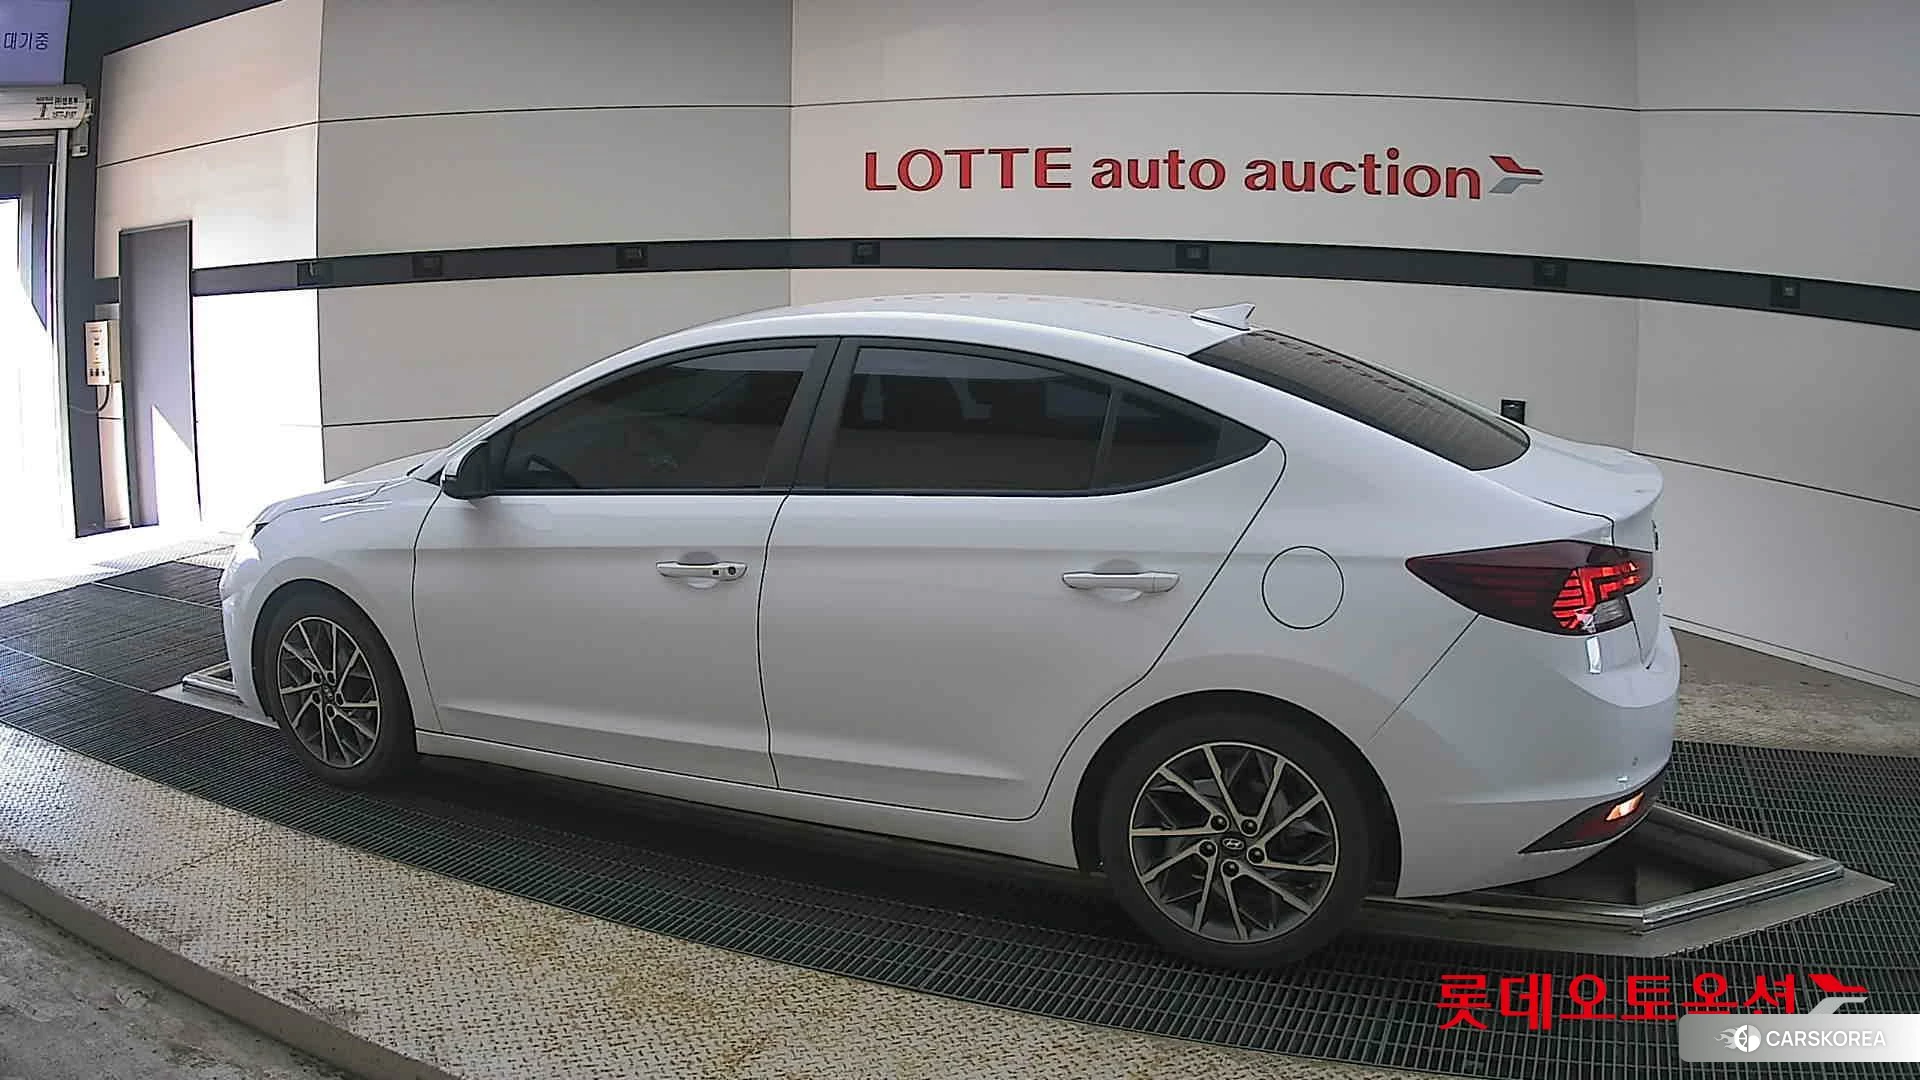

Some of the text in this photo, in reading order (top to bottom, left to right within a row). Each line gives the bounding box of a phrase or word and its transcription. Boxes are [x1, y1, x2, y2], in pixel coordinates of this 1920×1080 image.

[3, 31, 49, 50] 대기중
[865, 147, 1482, 199] LOTTE auto auction
